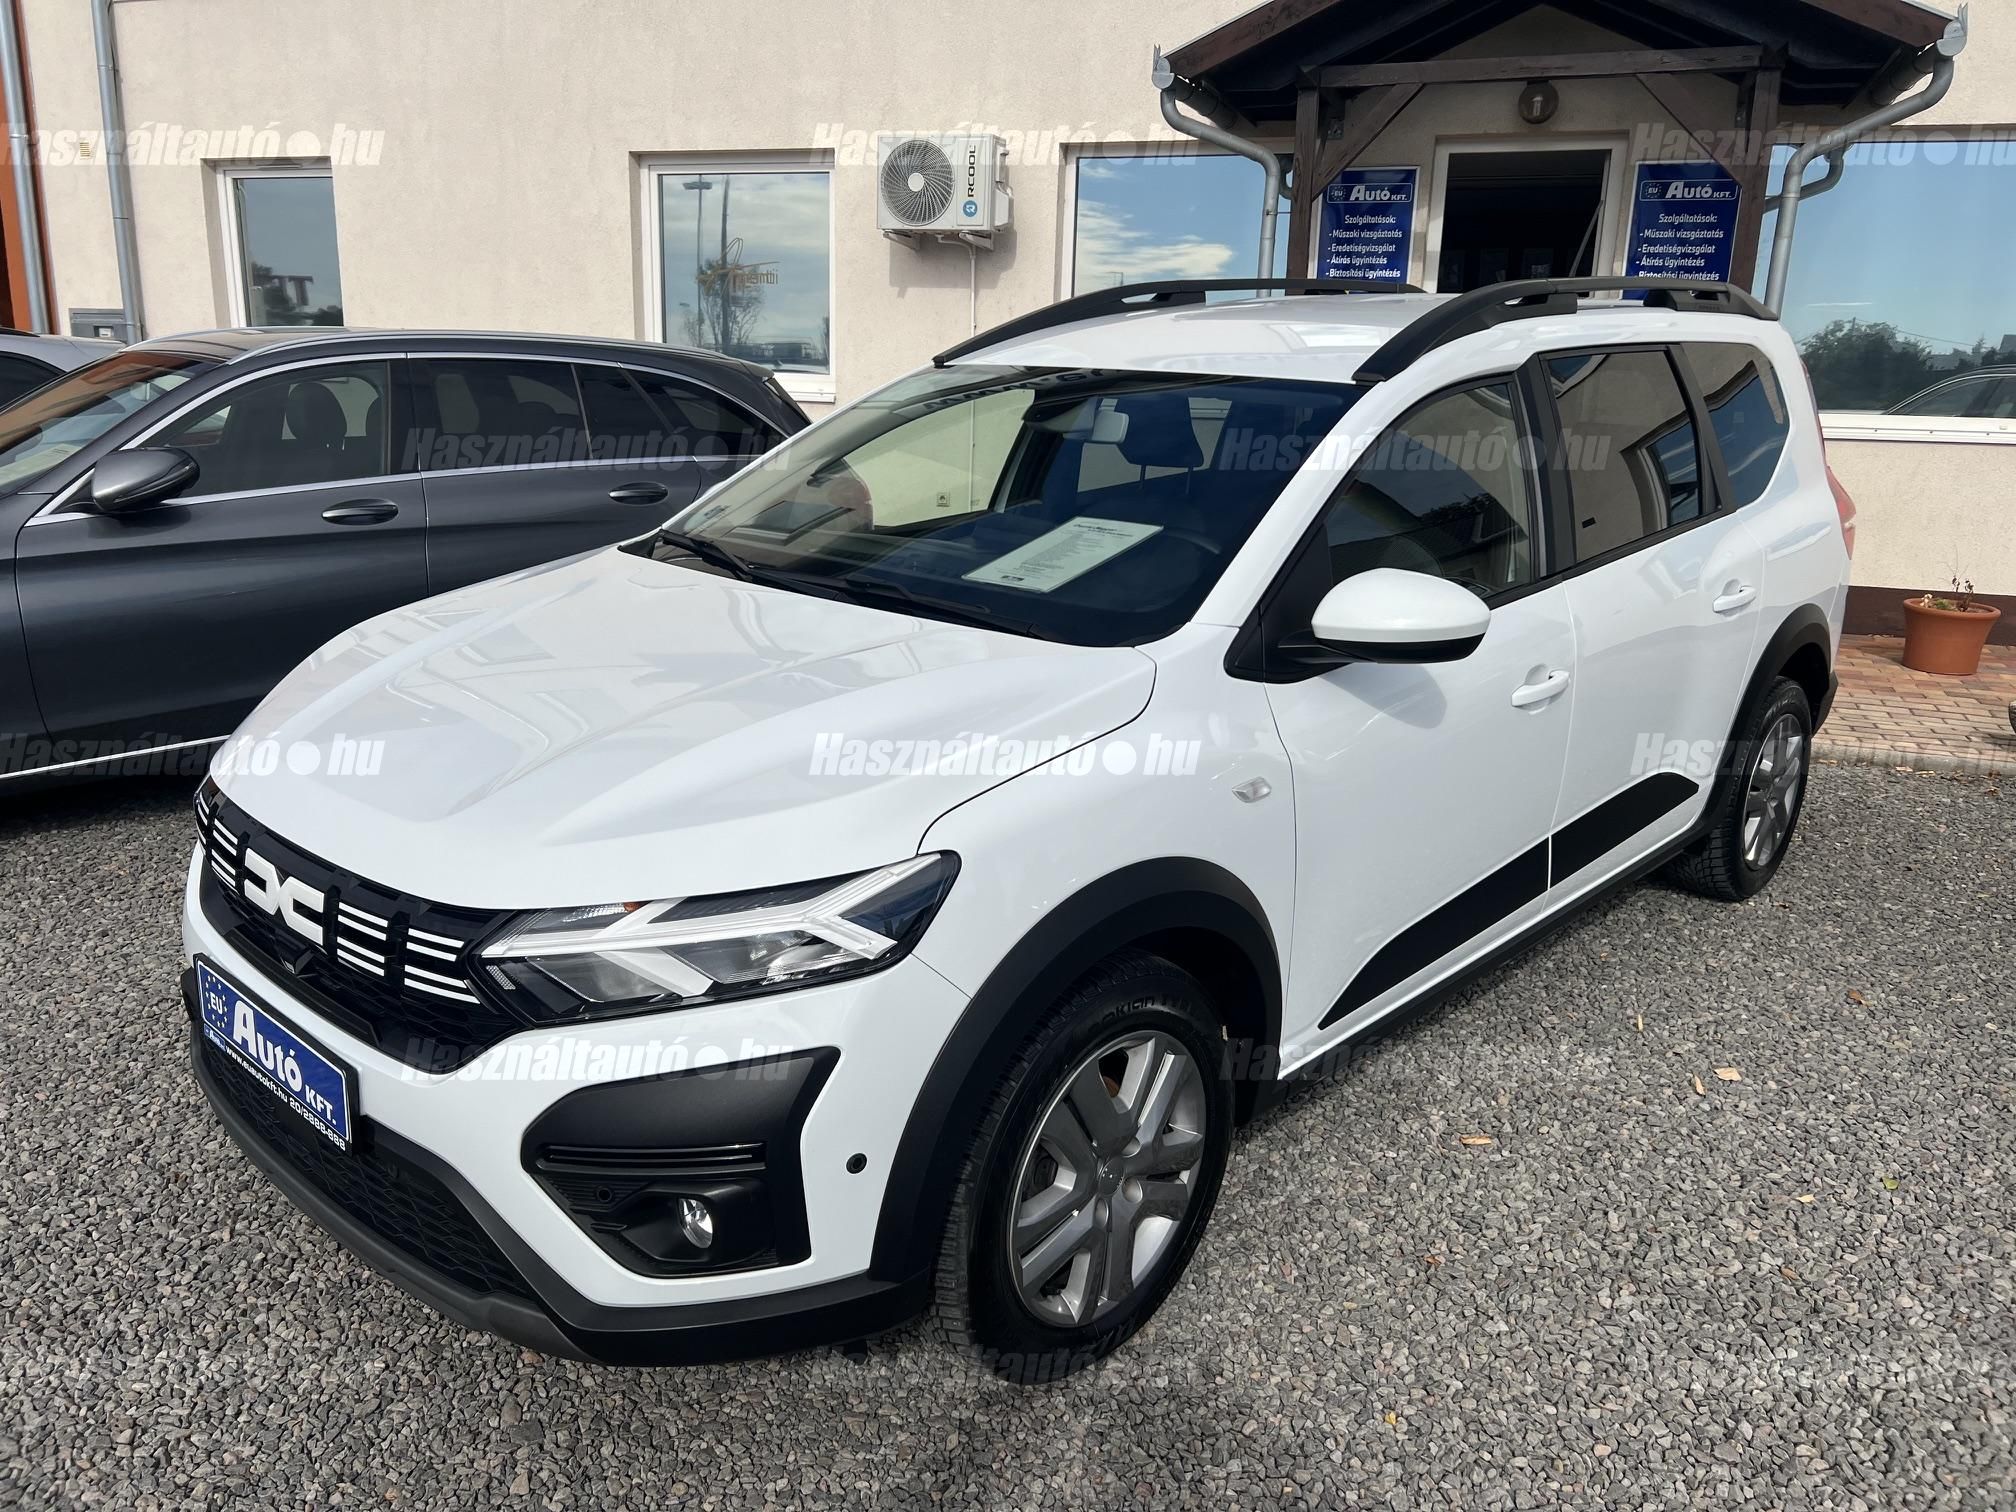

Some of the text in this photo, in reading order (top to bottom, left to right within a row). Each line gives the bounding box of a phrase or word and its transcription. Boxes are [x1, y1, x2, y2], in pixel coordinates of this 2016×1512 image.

[967, 145, 976, 198] RCOOL
[1349, 185, 1391, 200] Autó
[1665, 181, 1713, 198] Autó
[1344, 214, 1396, 226] Szolgáltatások:
[1658, 213, 1718, 225] Szolgáltatások:
[209, 991, 223, 1015] EU
[233, 1000, 303, 1092] Autó
[305, 1084, 337, 1125] KFT.
